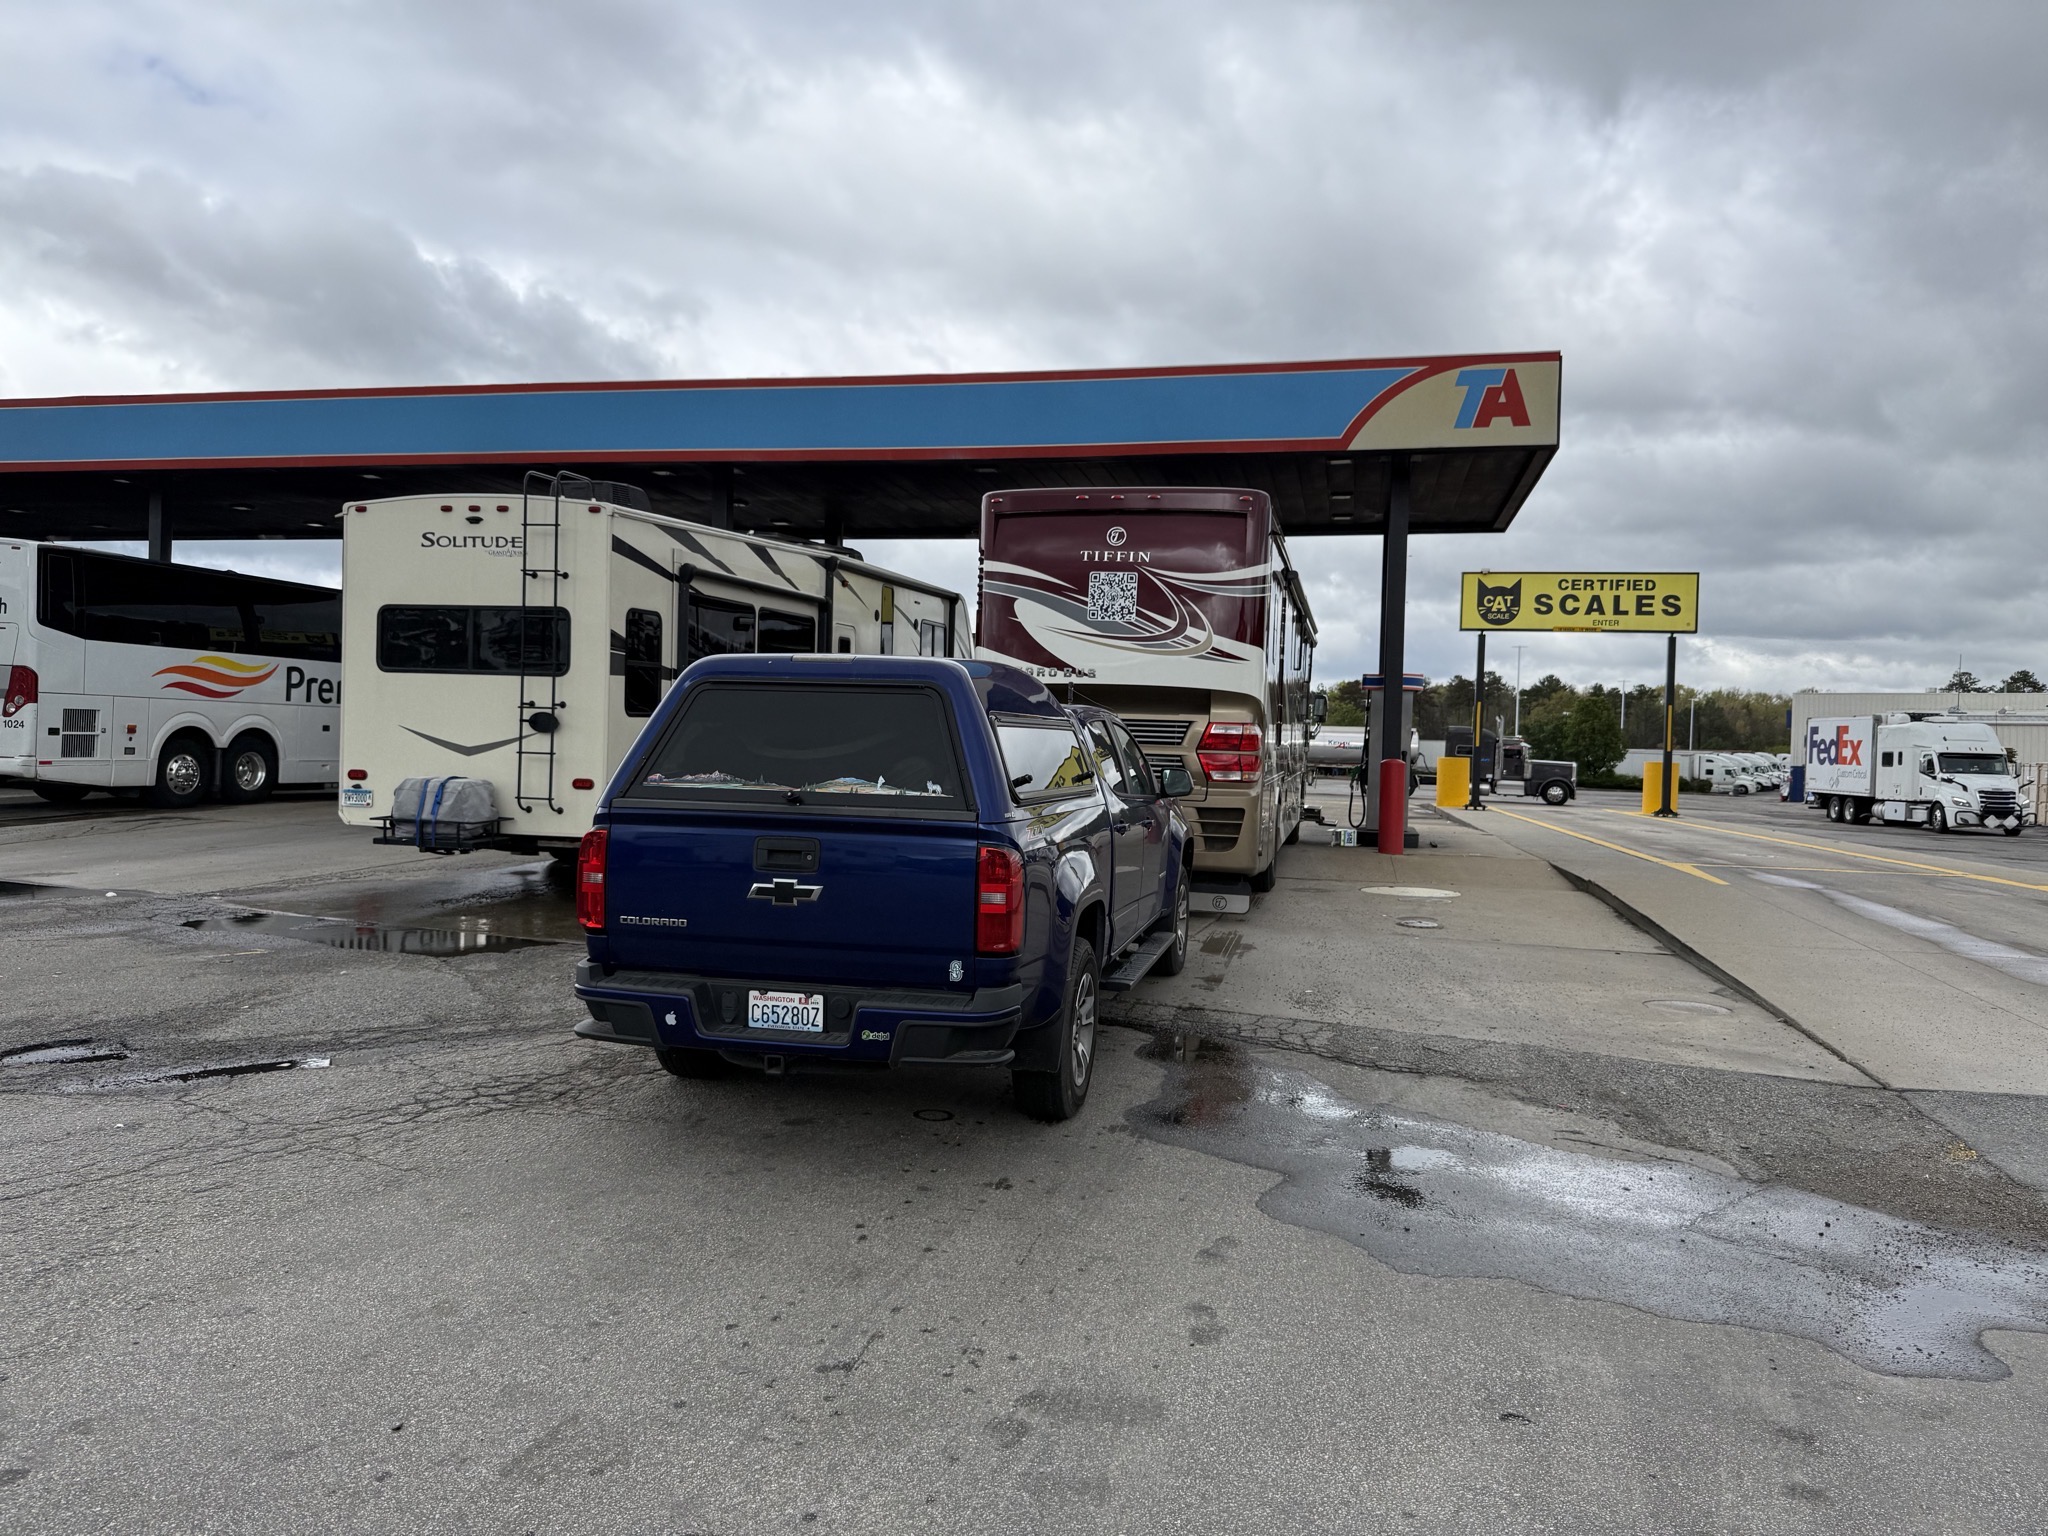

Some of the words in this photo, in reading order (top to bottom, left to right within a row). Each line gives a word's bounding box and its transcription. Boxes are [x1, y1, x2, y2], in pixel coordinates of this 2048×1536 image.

[1453, 368, 1531, 429] TA
[421, 531, 523, 548] SOLITUDE
[1080, 550, 1151, 563] TIFFIN
[1557, 578, 1657, 591] CERTIFIED
[1483, 595, 1514, 612] CAT
[1533, 593, 1682, 617] SCALES
[1487, 612, 1510, 620] SCALE
[1592, 619, 1620, 627] ENTER
[1063, 667, 1097, 678] BUS
[3, 719, 25, 729] 1024
[1809, 725, 1863, 766] FedEx
[620, 915, 687, 927] COLORADO
[752, 995, 795, 1004] WASHINGTON
[751, 1003, 820, 1028] C65280Z
